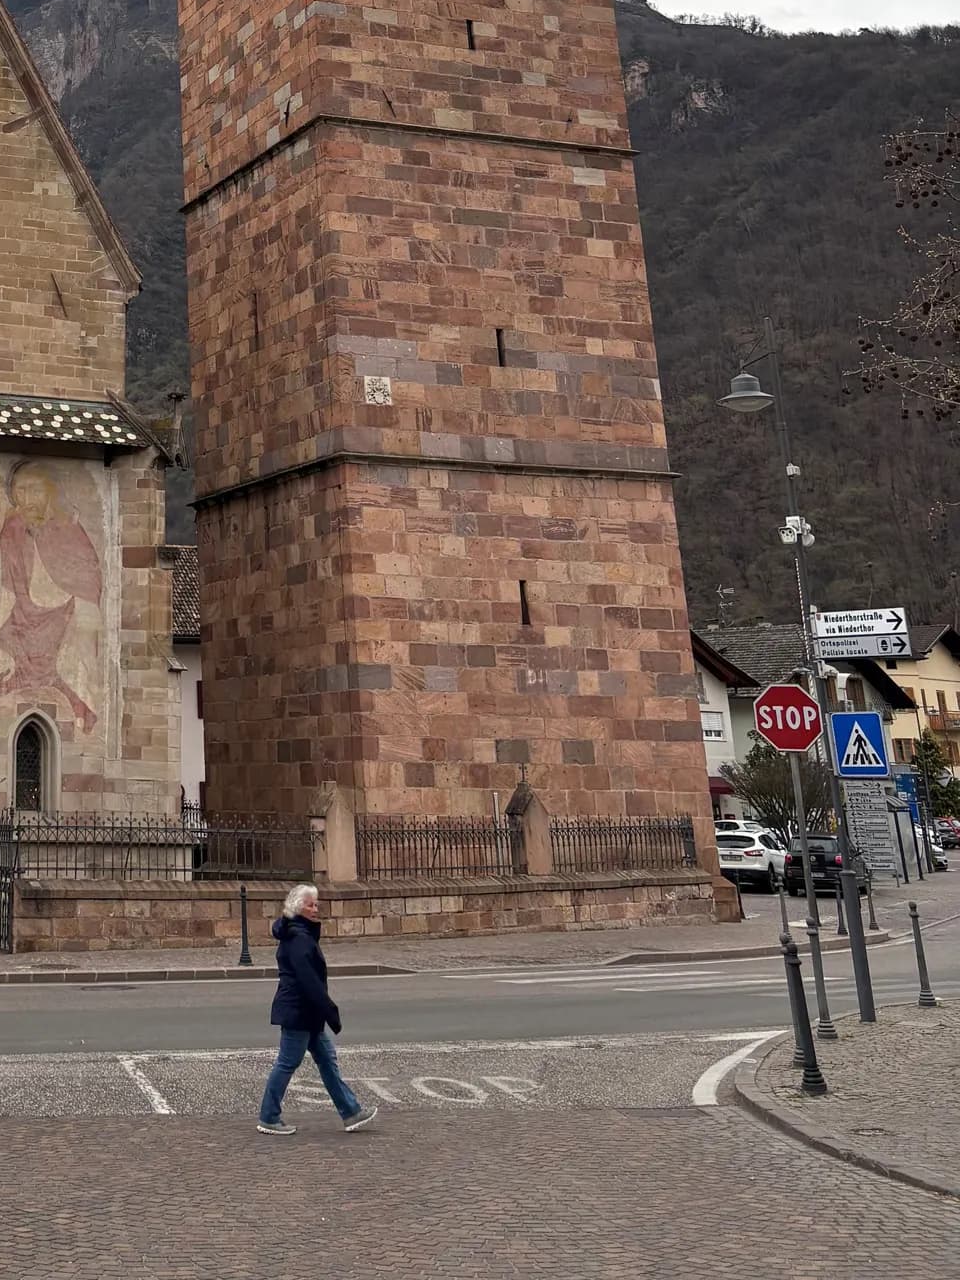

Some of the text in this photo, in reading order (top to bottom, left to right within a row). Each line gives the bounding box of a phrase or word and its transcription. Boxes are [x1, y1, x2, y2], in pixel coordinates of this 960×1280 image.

[823, 612, 883, 623] Niederthorstraße
[825, 624, 874, 634] via Niederthor
[822, 649, 844, 657] Polizia
[759, 705, 817, 730] STOP
